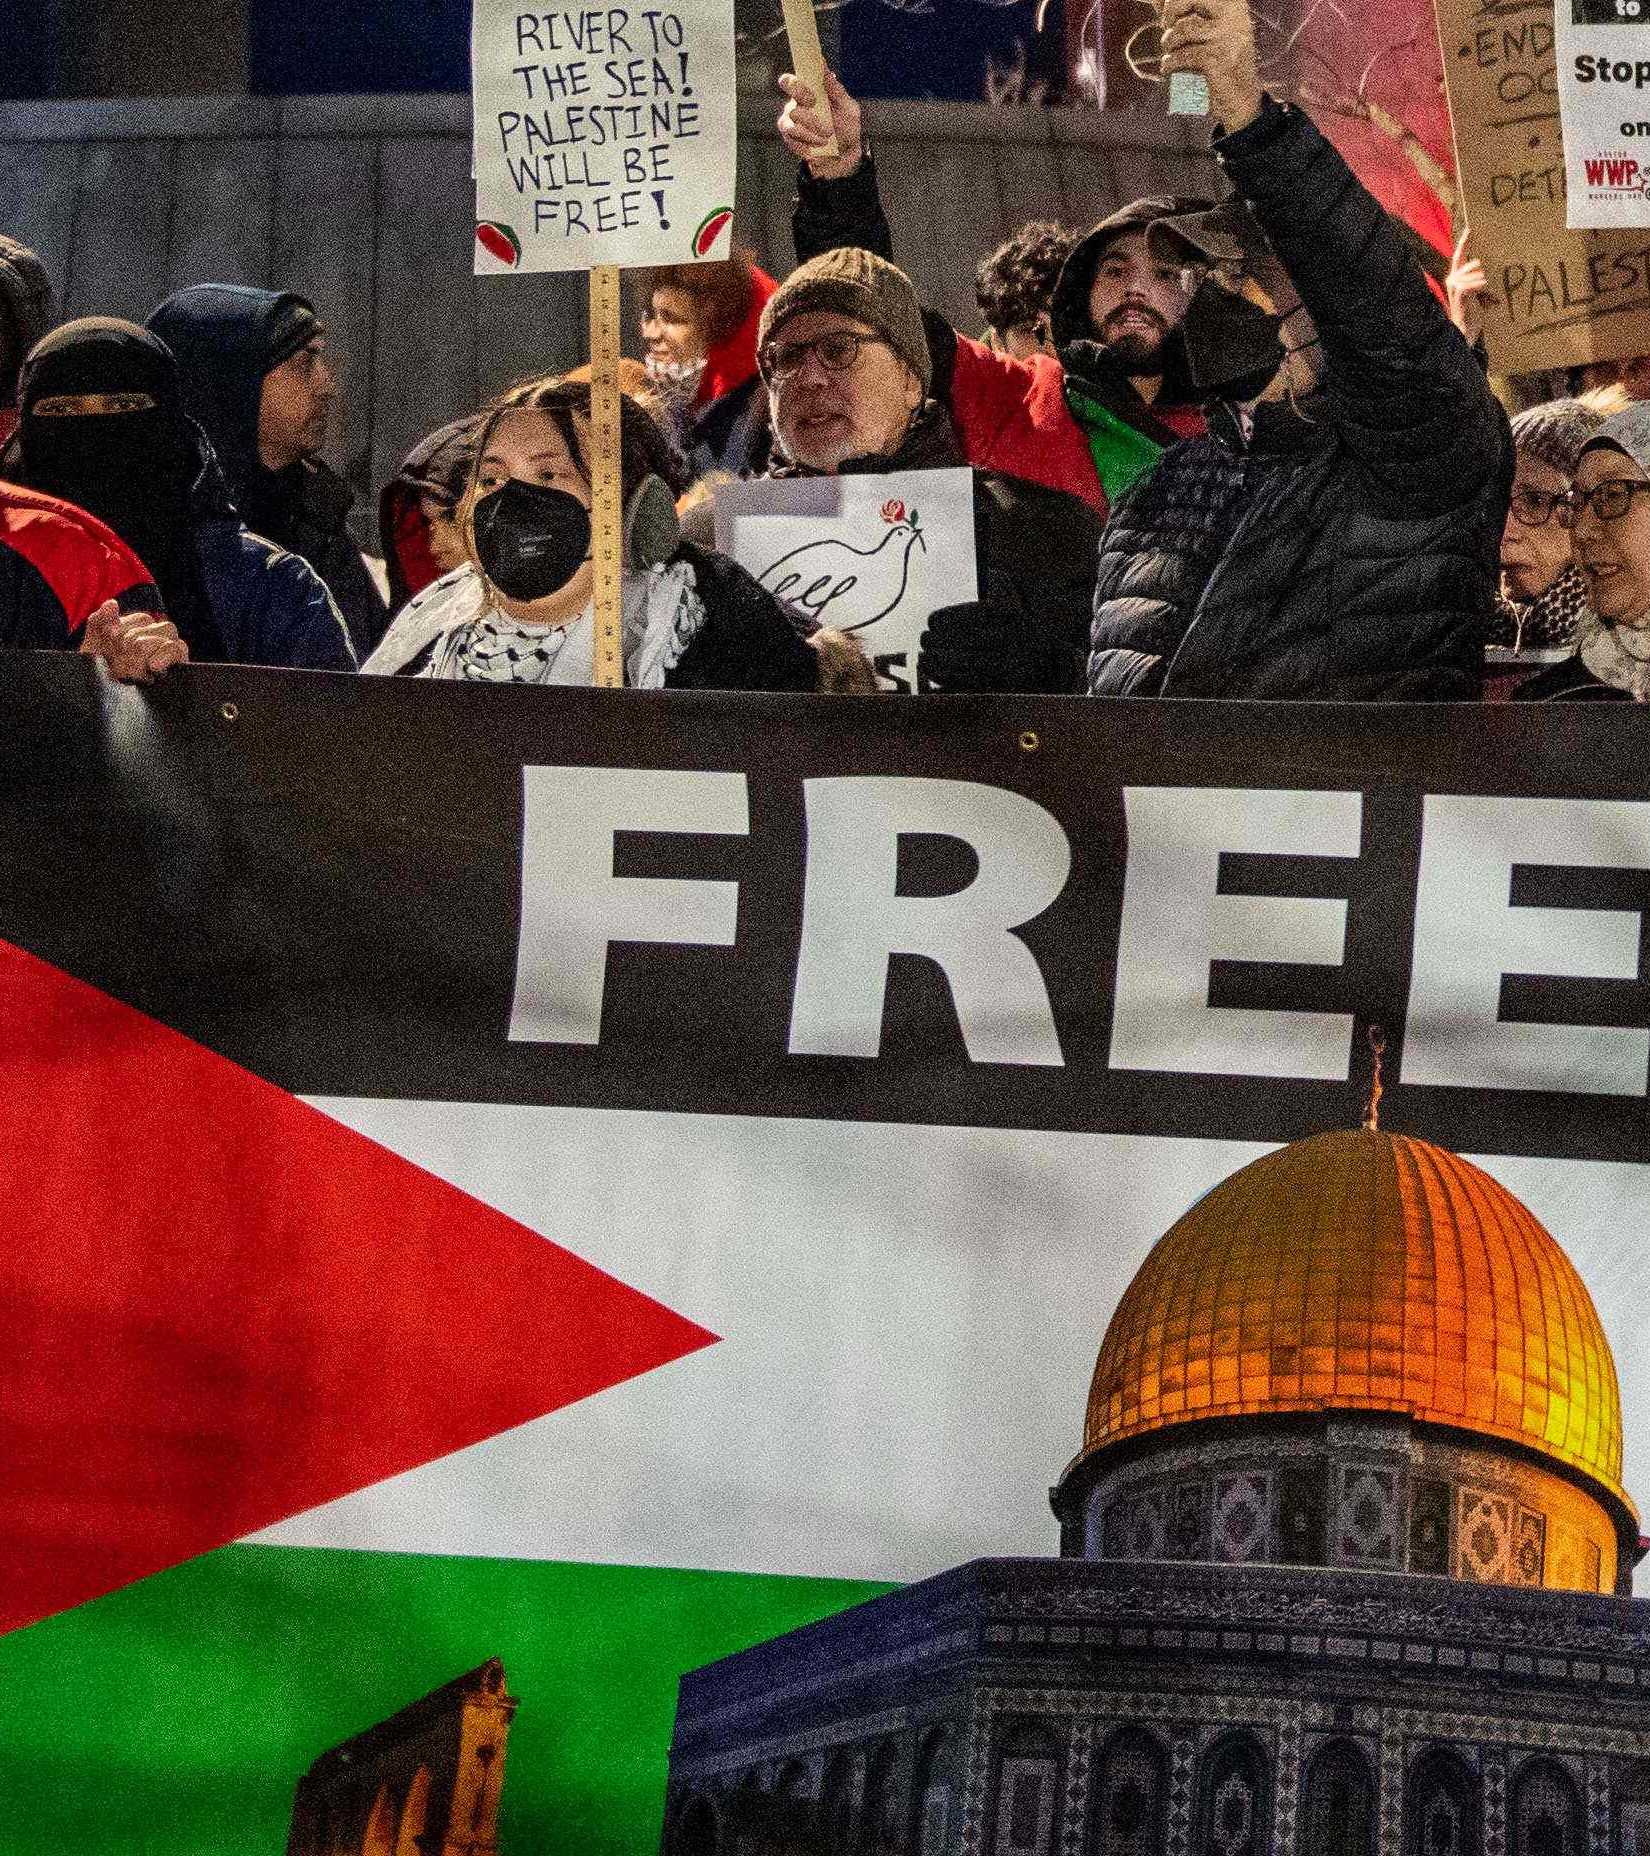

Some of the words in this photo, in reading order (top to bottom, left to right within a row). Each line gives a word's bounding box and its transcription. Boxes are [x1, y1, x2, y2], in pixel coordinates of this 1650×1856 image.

[516, 9, 633, 55] RIVER
[641, 11, 684, 54] TO
[513, 61, 591, 101] THE
[605, 51, 693, 98] SEA!
[498, 102, 700, 155] PALESTINE
[507, 153, 611, 194] WILL
[624, 145, 674, 185] BE
[1585, 160, 1639, 186] WWP
[534, 190, 671, 237] FREE!
